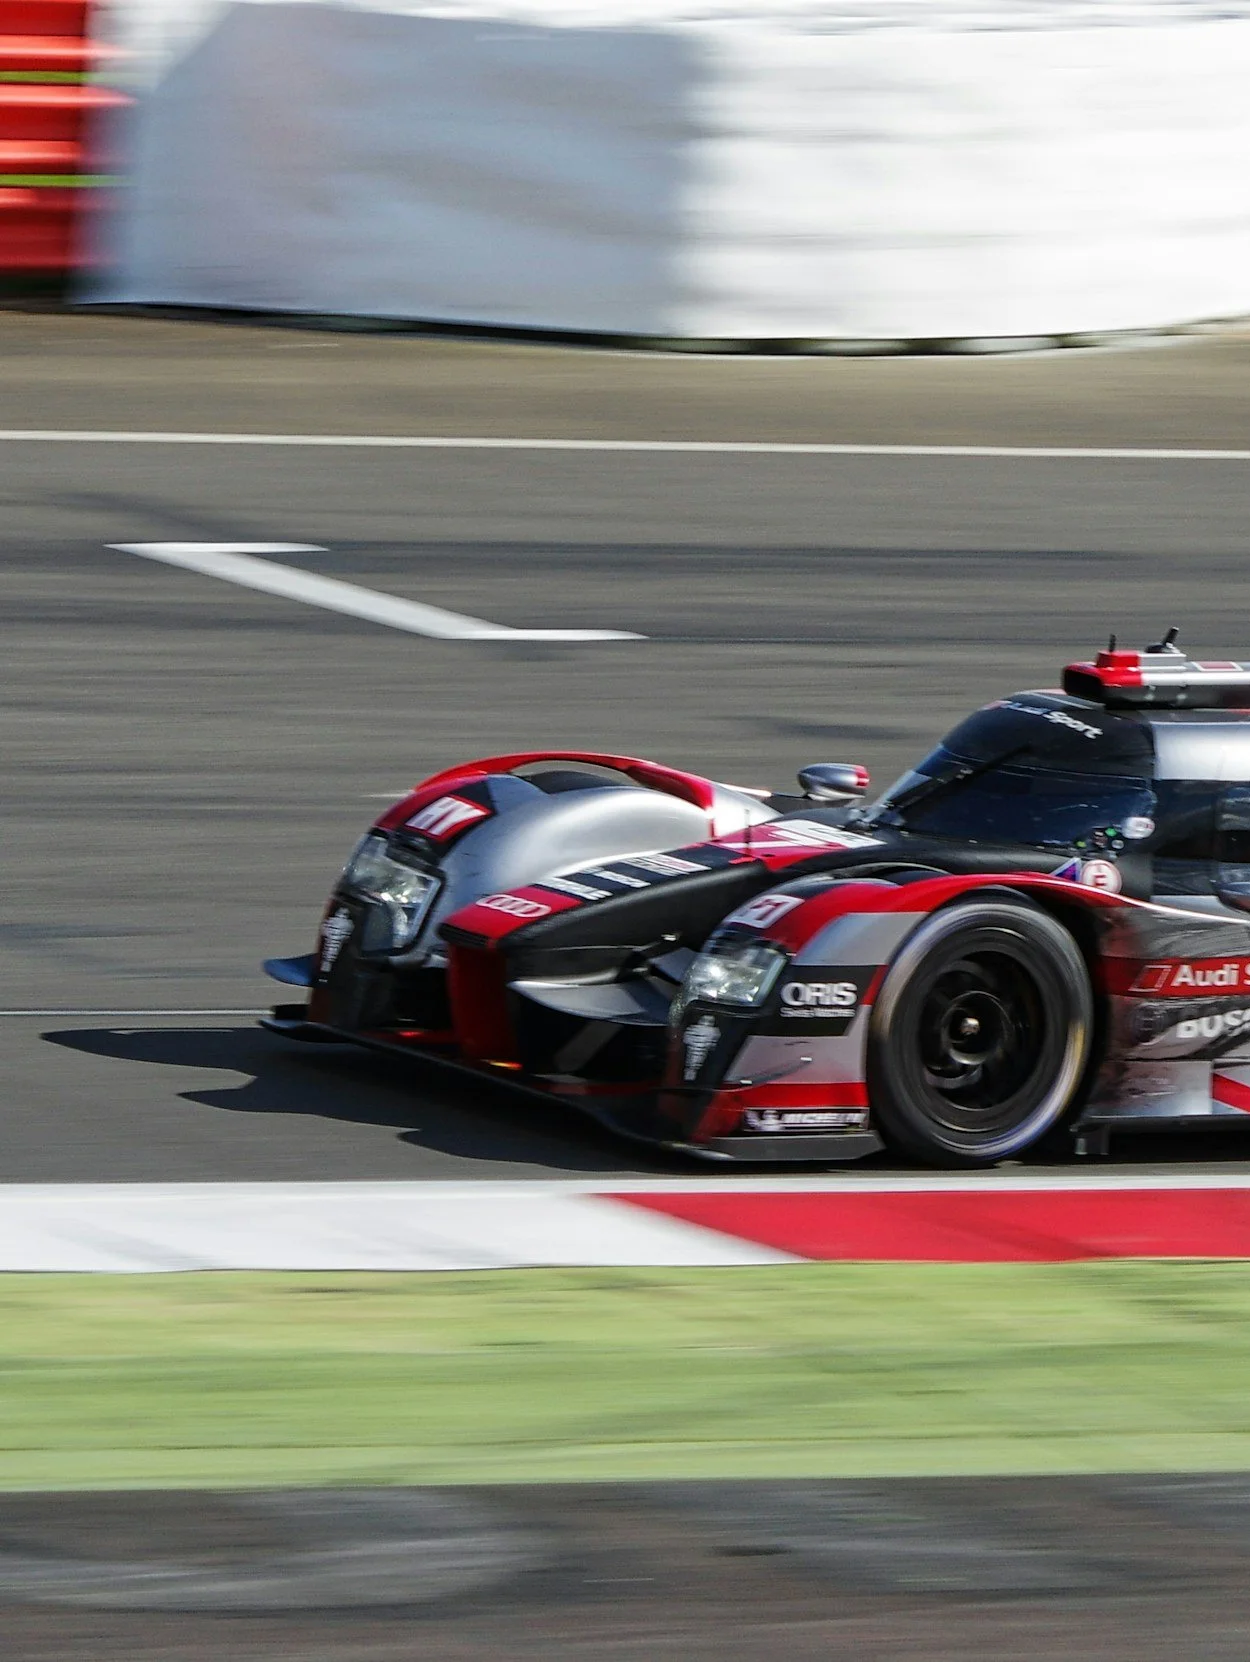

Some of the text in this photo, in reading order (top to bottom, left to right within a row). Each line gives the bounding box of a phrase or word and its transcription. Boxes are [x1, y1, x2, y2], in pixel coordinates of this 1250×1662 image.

[404, 796, 488, 837] HY
[1170, 964, 1240, 987] Audi
[781, 982, 858, 1006] ORIS
